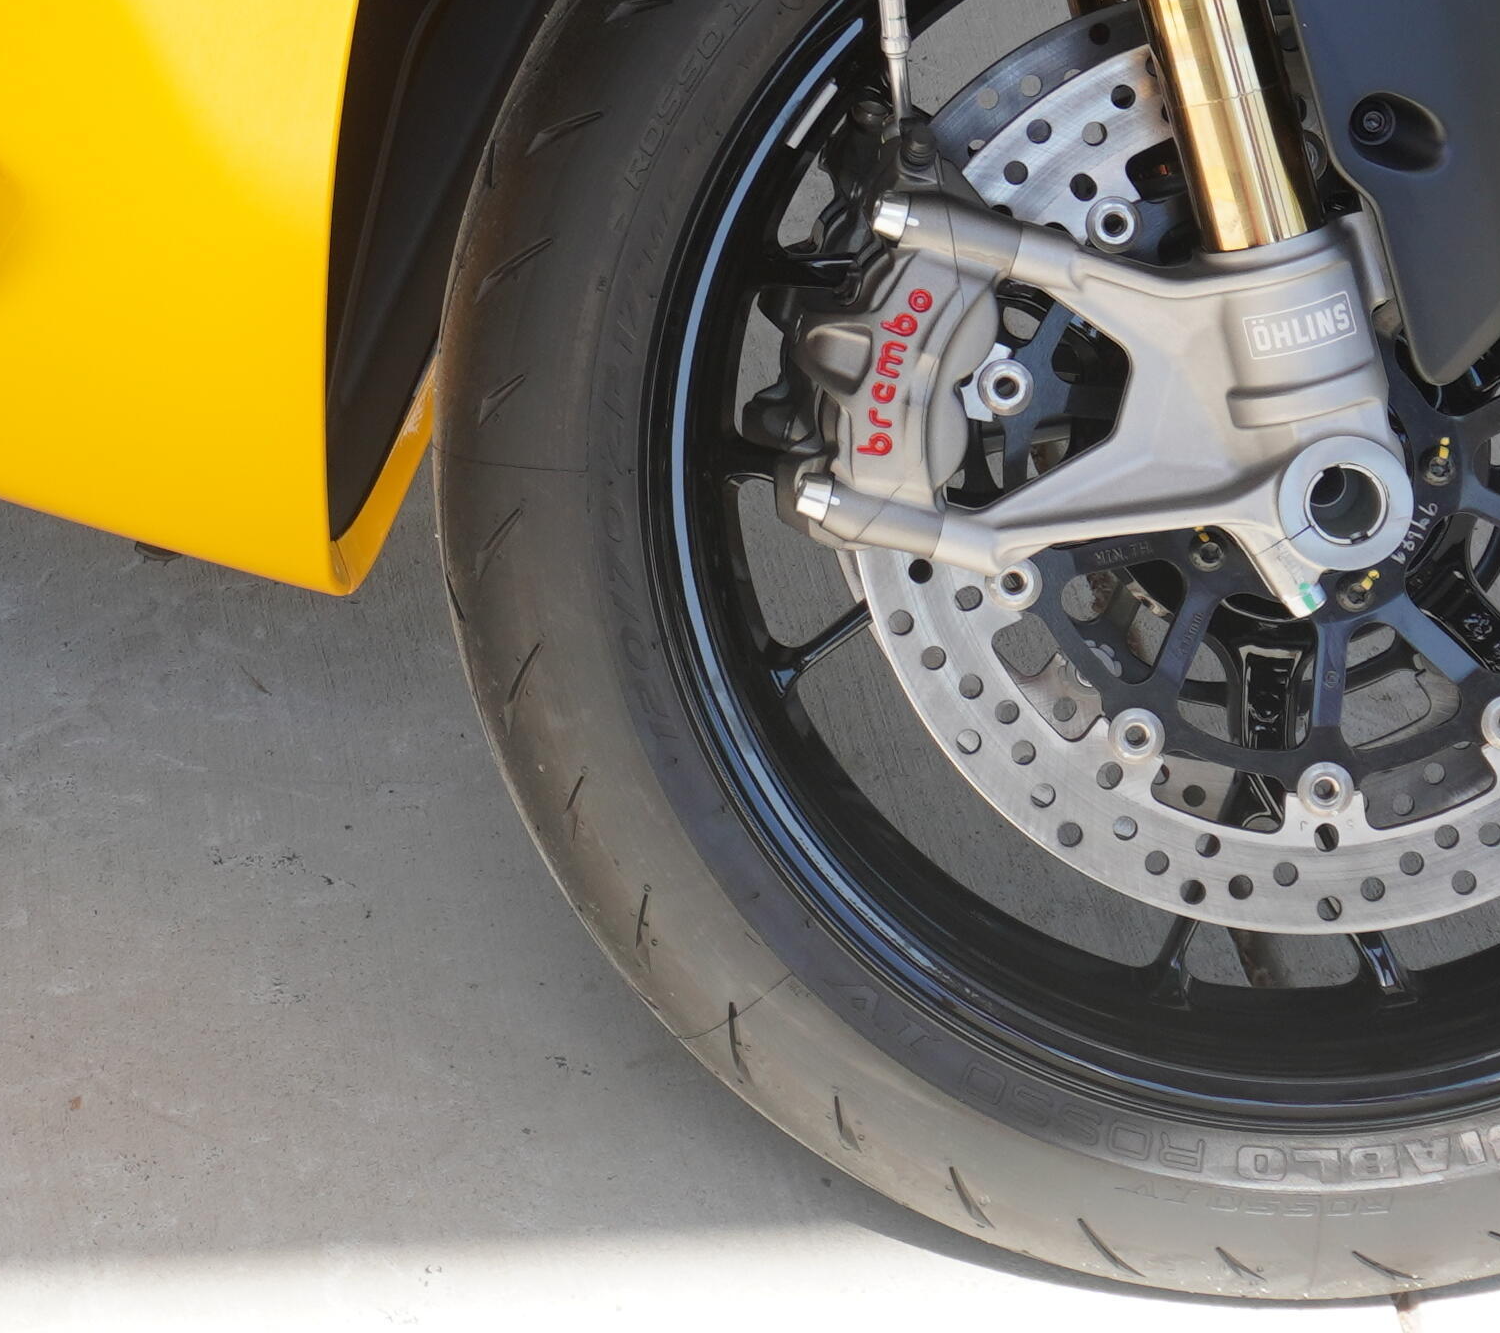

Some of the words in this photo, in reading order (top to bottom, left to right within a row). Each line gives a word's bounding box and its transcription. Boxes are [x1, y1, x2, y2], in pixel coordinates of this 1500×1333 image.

[618, 23, 727, 193] ROSSO
[856, 288, 933, 457] brembo
[1251, 300, 1353, 353] ÖHLINS
[814, 954, 940, 1061] IV
[952, 1054, 1210, 1173] ROSSO
[1207, 1188, 1394, 1216] ROSSO
